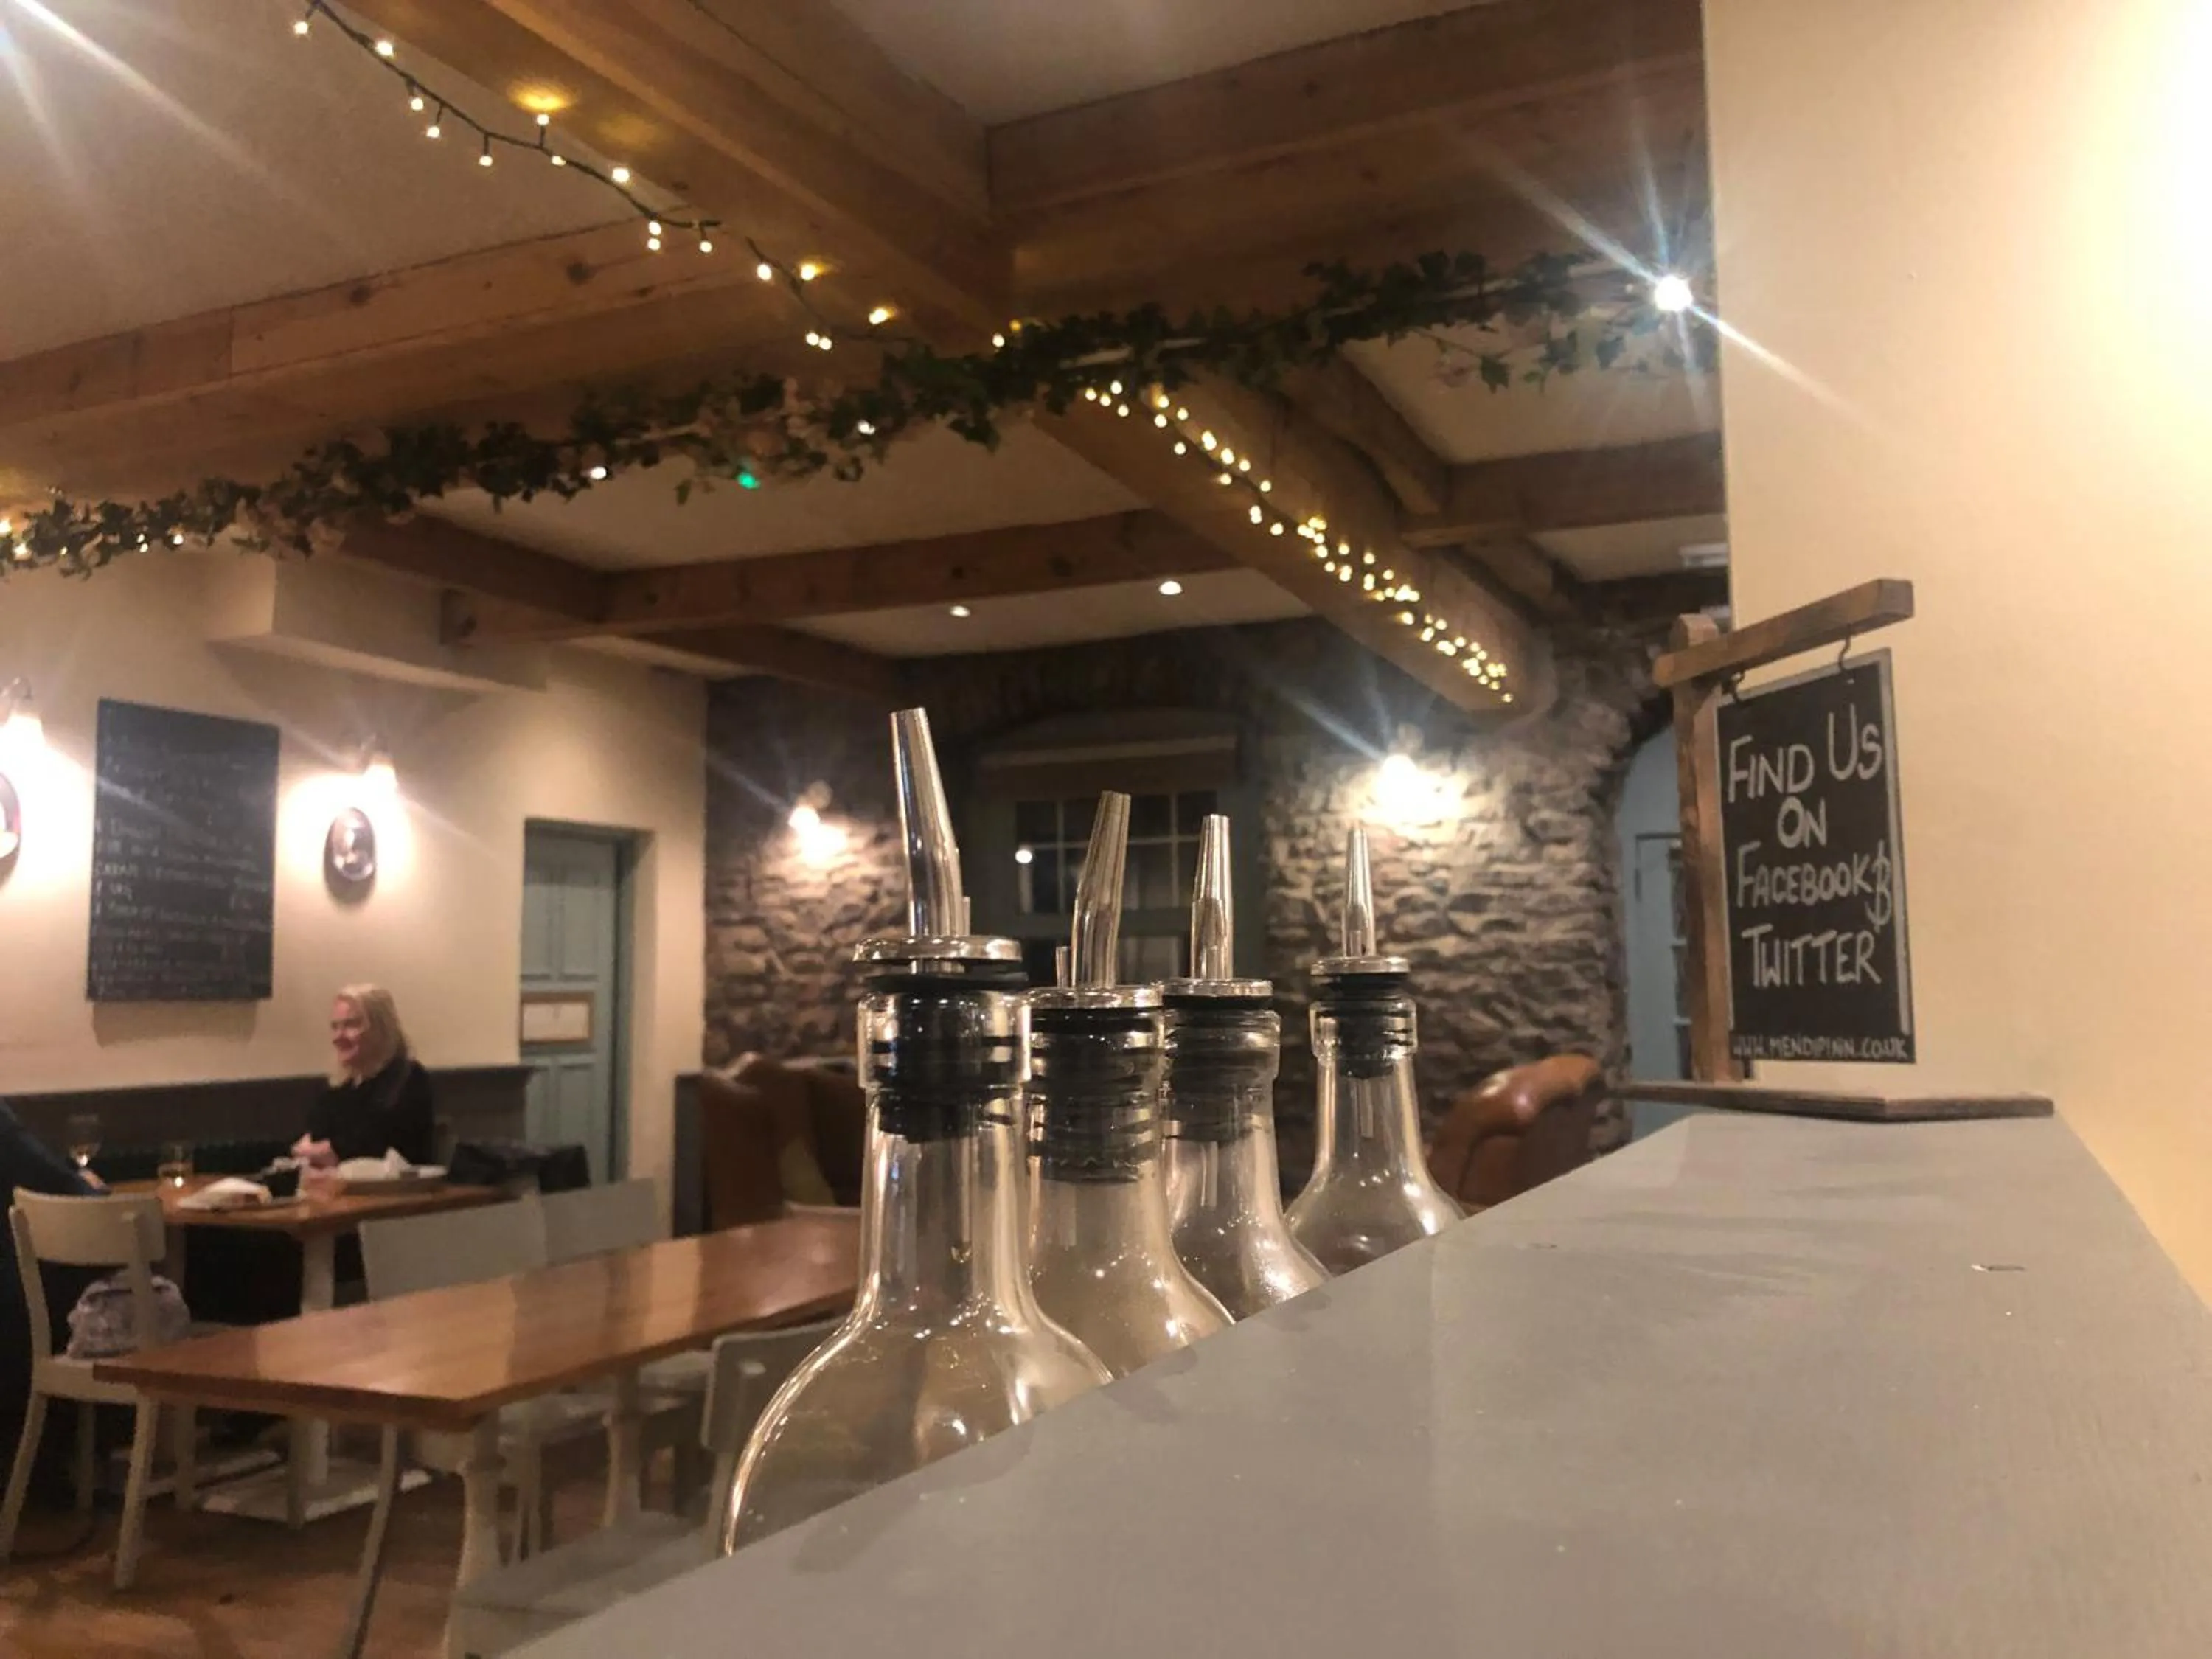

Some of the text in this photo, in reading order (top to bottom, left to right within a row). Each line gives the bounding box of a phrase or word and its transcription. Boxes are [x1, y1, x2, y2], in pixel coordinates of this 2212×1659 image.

[1728, 703, 1882, 803] FIND US
[1777, 796, 1826, 848] ON
[1741, 923, 1882, 988] TWITTER
